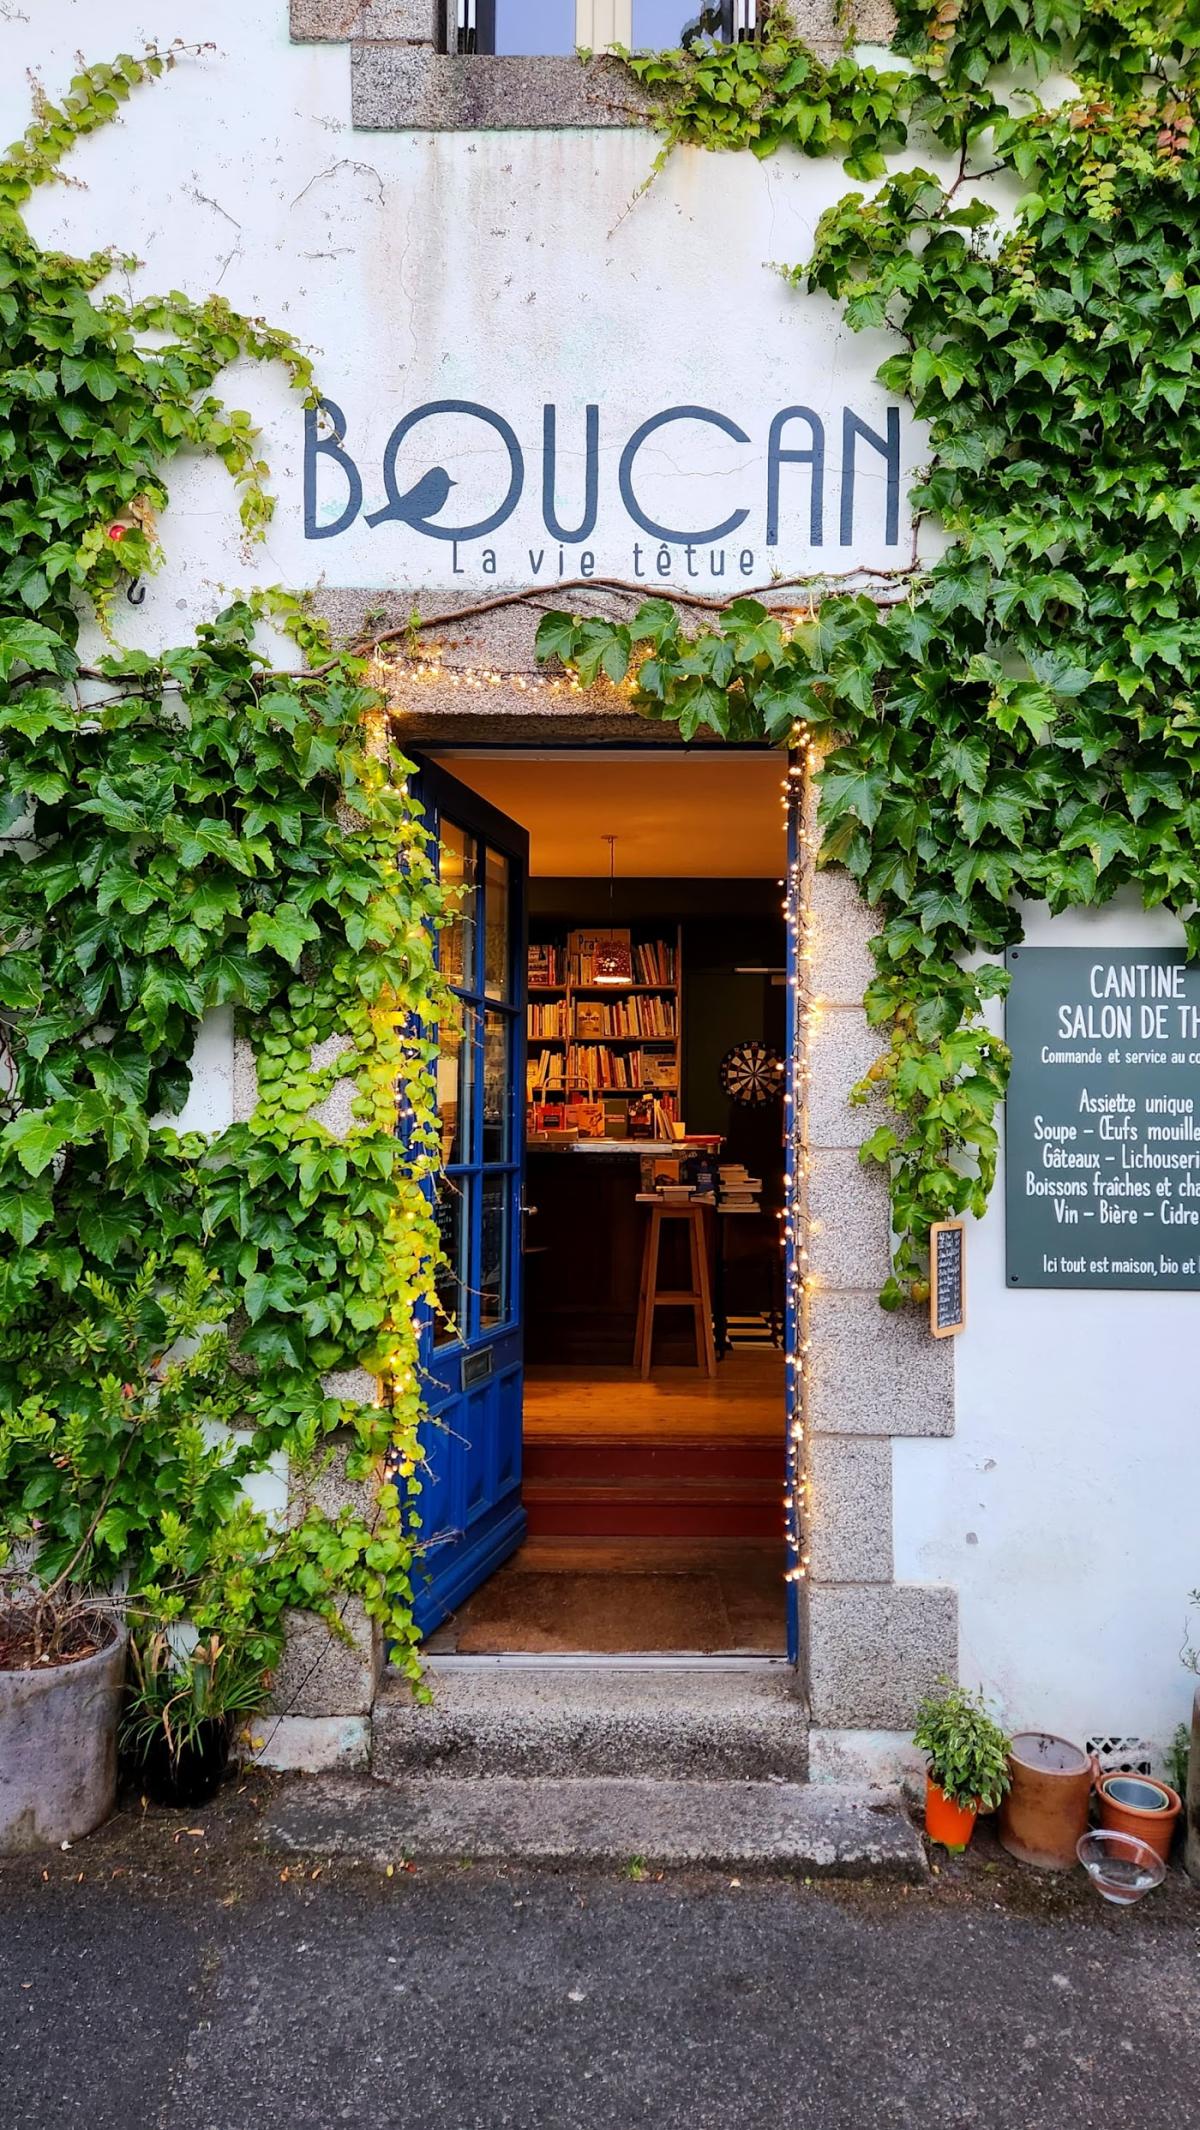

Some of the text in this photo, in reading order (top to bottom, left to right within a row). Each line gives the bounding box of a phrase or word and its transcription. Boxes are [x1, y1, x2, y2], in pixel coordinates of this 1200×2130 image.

[303, 397, 901, 547] BOUCAN
[452, 539, 755, 578] La vie têtue
[1090, 964, 1187, 999] CANTINE
[1058, 1004, 1132, 1039] SALON
[1140, 1004, 1169, 1039] DE
[1041, 1045, 1103, 1064] Commande
[1107, 1048, 1121, 1064] et
[1124, 1048, 1167, 1064] service
[1170, 1052, 1186, 1064] au
[1079, 1088, 1194, 1117] Assiette unique
[1033, 1115, 1077, 1145] Soupe
[1099, 1114, 1139, 1141] Œufs
[1042, 1142, 1101, 1169] Gâteaux
[1121, 1143, 1200, 1170] Lichouseri
[1026, 1170, 1088, 1197] Boissons
[1093, 1171, 1151, 1197] fraîches
[1155, 1176, 1172, 1197] et
[1053, 1198, 1079, 1224] Vin
[1099, 1199, 1138, 1225] Bière
[1160, 1199, 1199, 1225] Cidre
[1043, 1254, 1058, 1273] Ici
[1060, 1256, 1087, 1273] tout
[1089, 1256, 1110, 1273] est
[1111, 1257, 1158, 1277] maison,
[1160, 1254, 1179, 1274] bio
[1182, 1258, 1196, 1274] et
